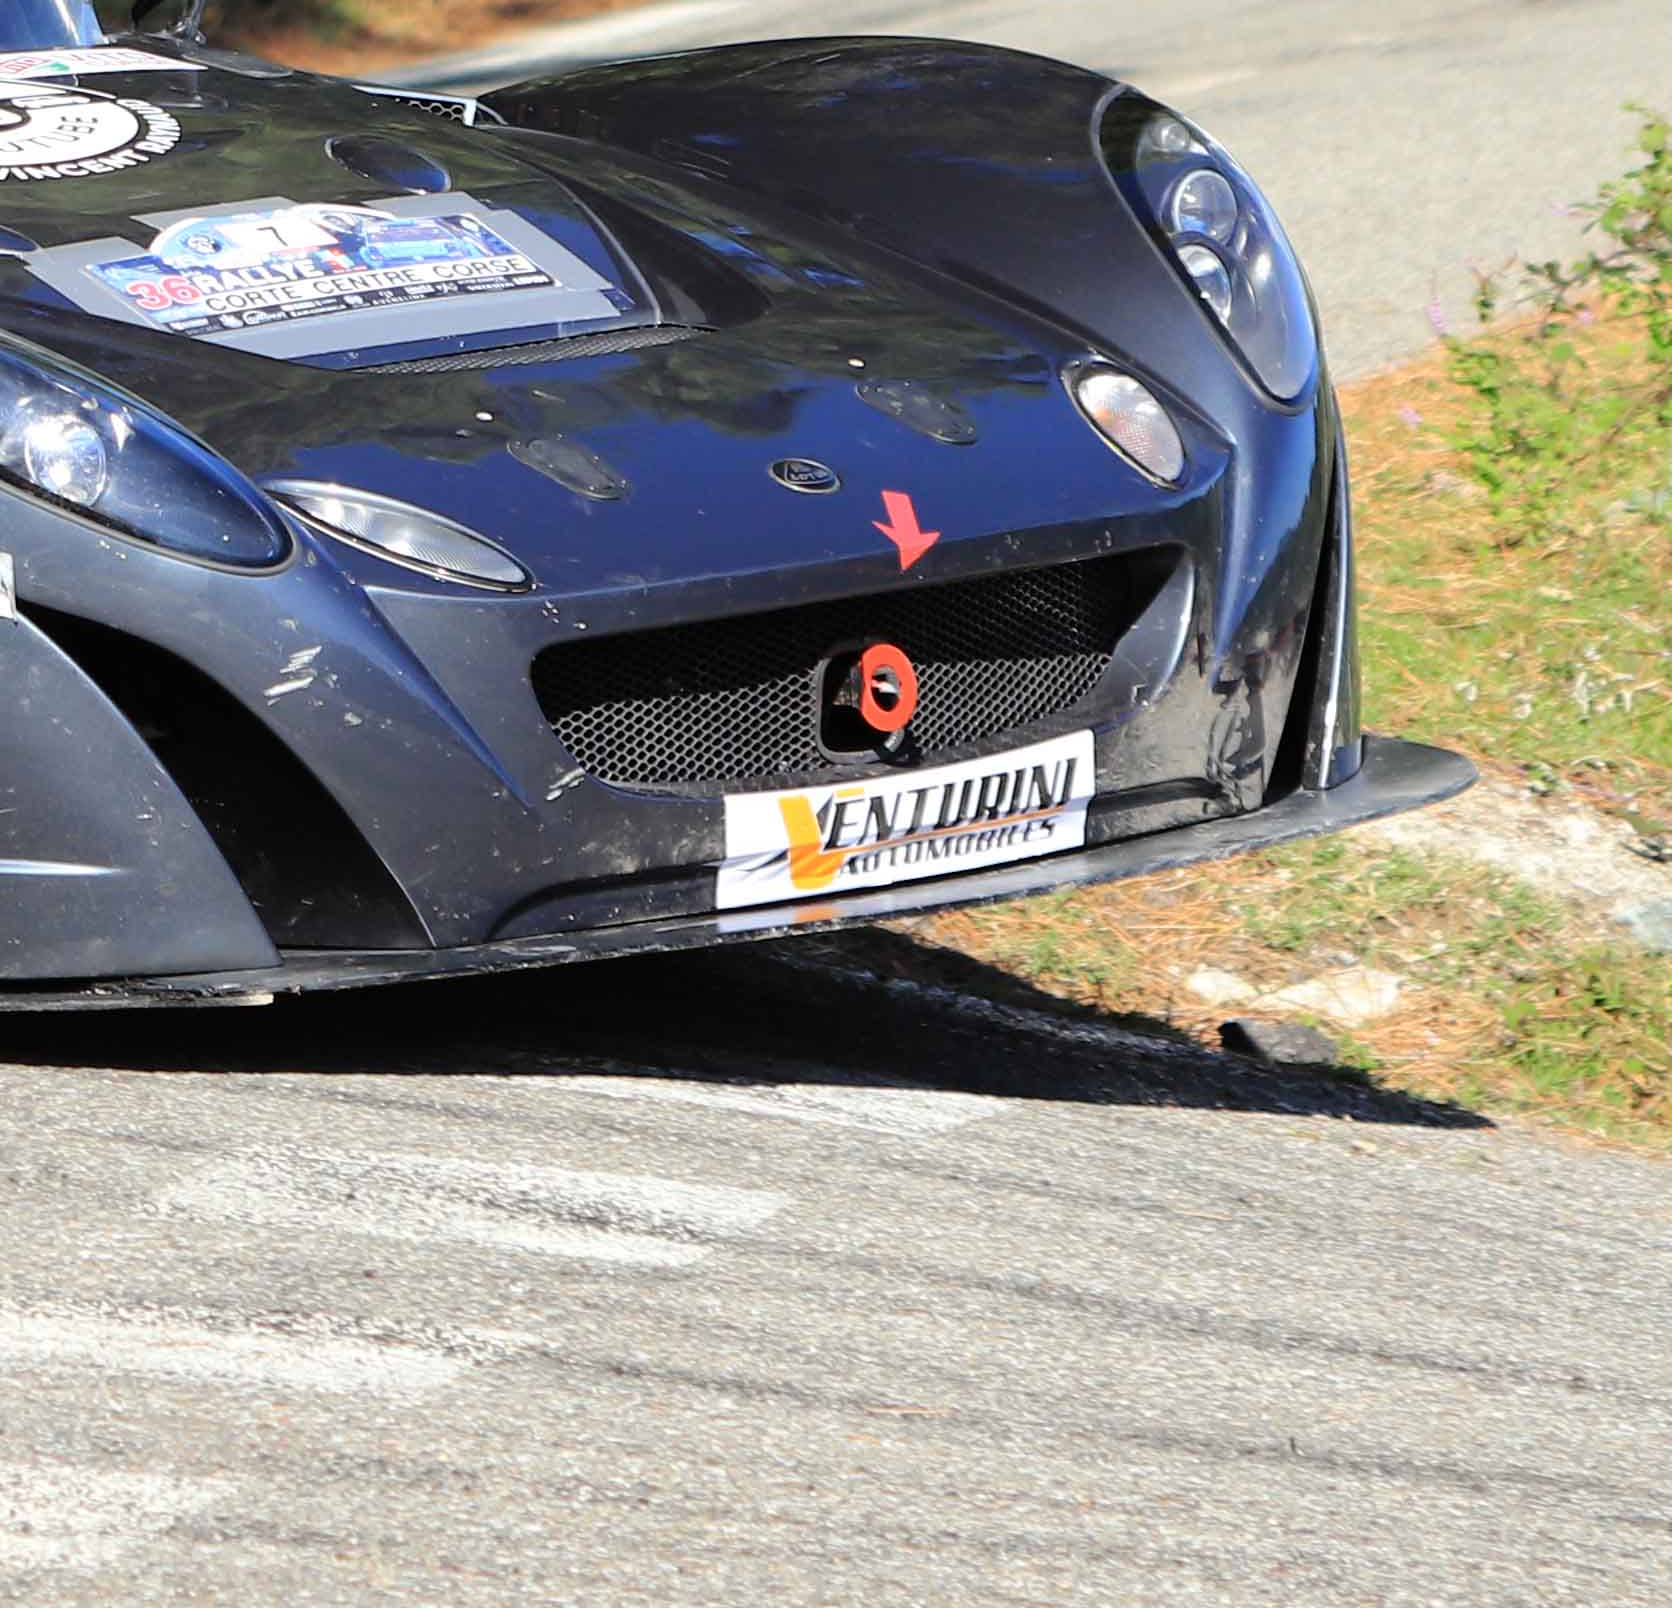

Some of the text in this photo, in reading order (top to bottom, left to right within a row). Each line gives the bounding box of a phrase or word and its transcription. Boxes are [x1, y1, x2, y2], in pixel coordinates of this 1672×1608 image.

[256, 226, 289, 247] 7
[125, 275, 203, 312] 36
[193, 257, 325, 295] RALLYE
[205, 284, 298, 314] CORTE
[313, 265, 428, 296] CENTRE
[434, 256, 528, 280] CORSE
[778, 758, 1079, 890] VENTURINI
[839, 817, 1056, 877] AUTOMOBILES
